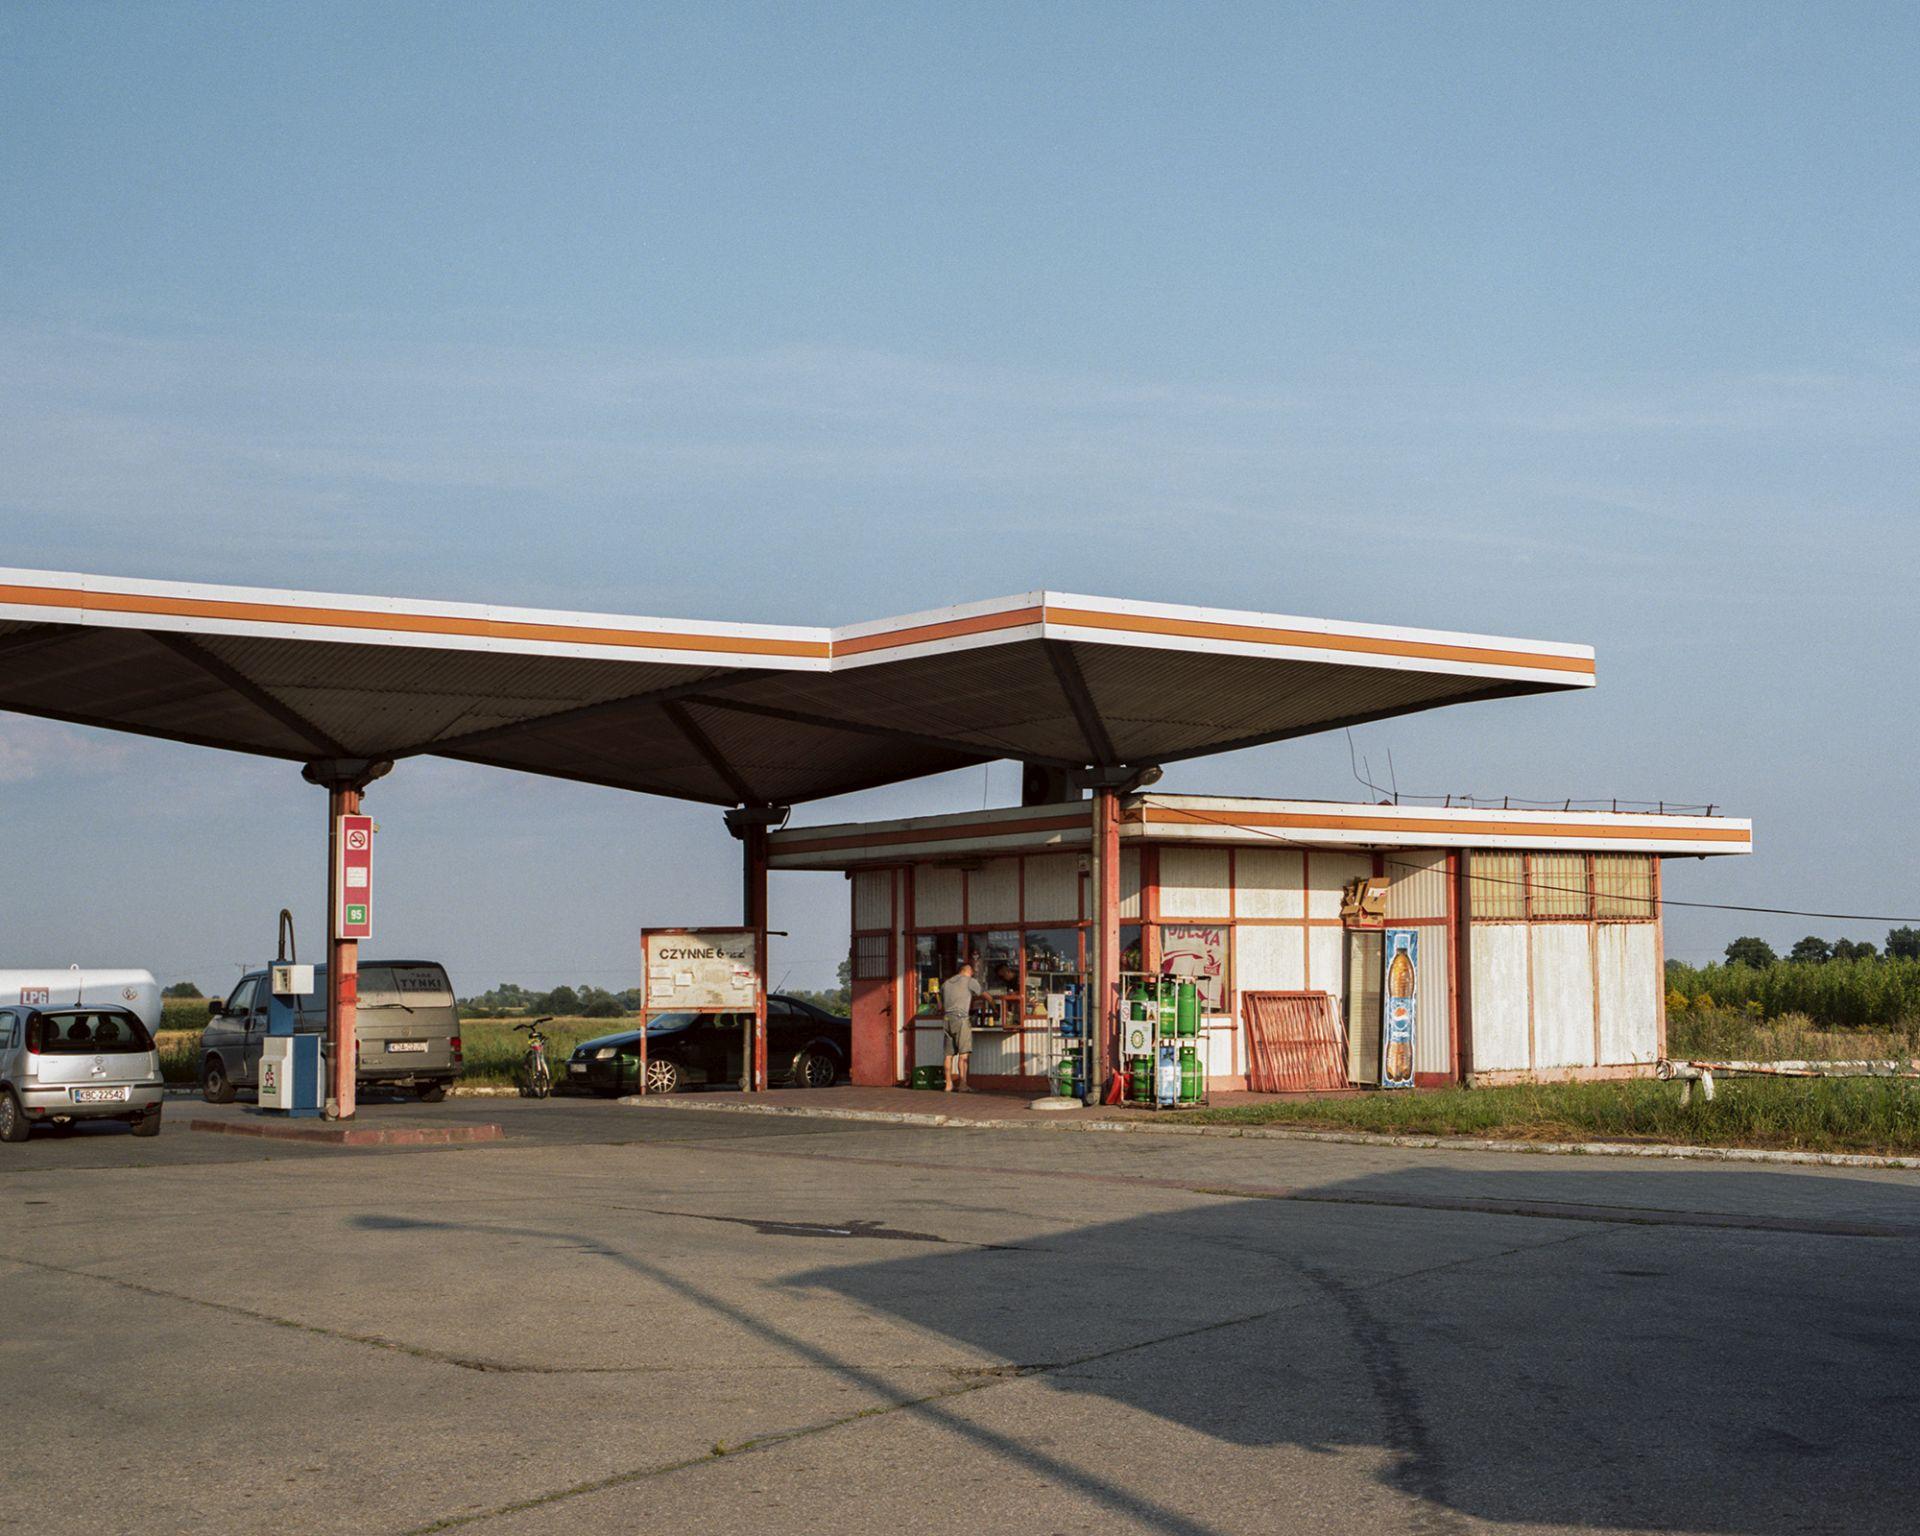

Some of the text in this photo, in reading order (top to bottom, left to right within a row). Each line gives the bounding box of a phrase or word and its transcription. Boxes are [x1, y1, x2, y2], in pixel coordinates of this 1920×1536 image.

[351, 909, 362, 921] 95
[659, 948, 714, 960] CZYNNE
[22, 991, 48, 1001] LPG
